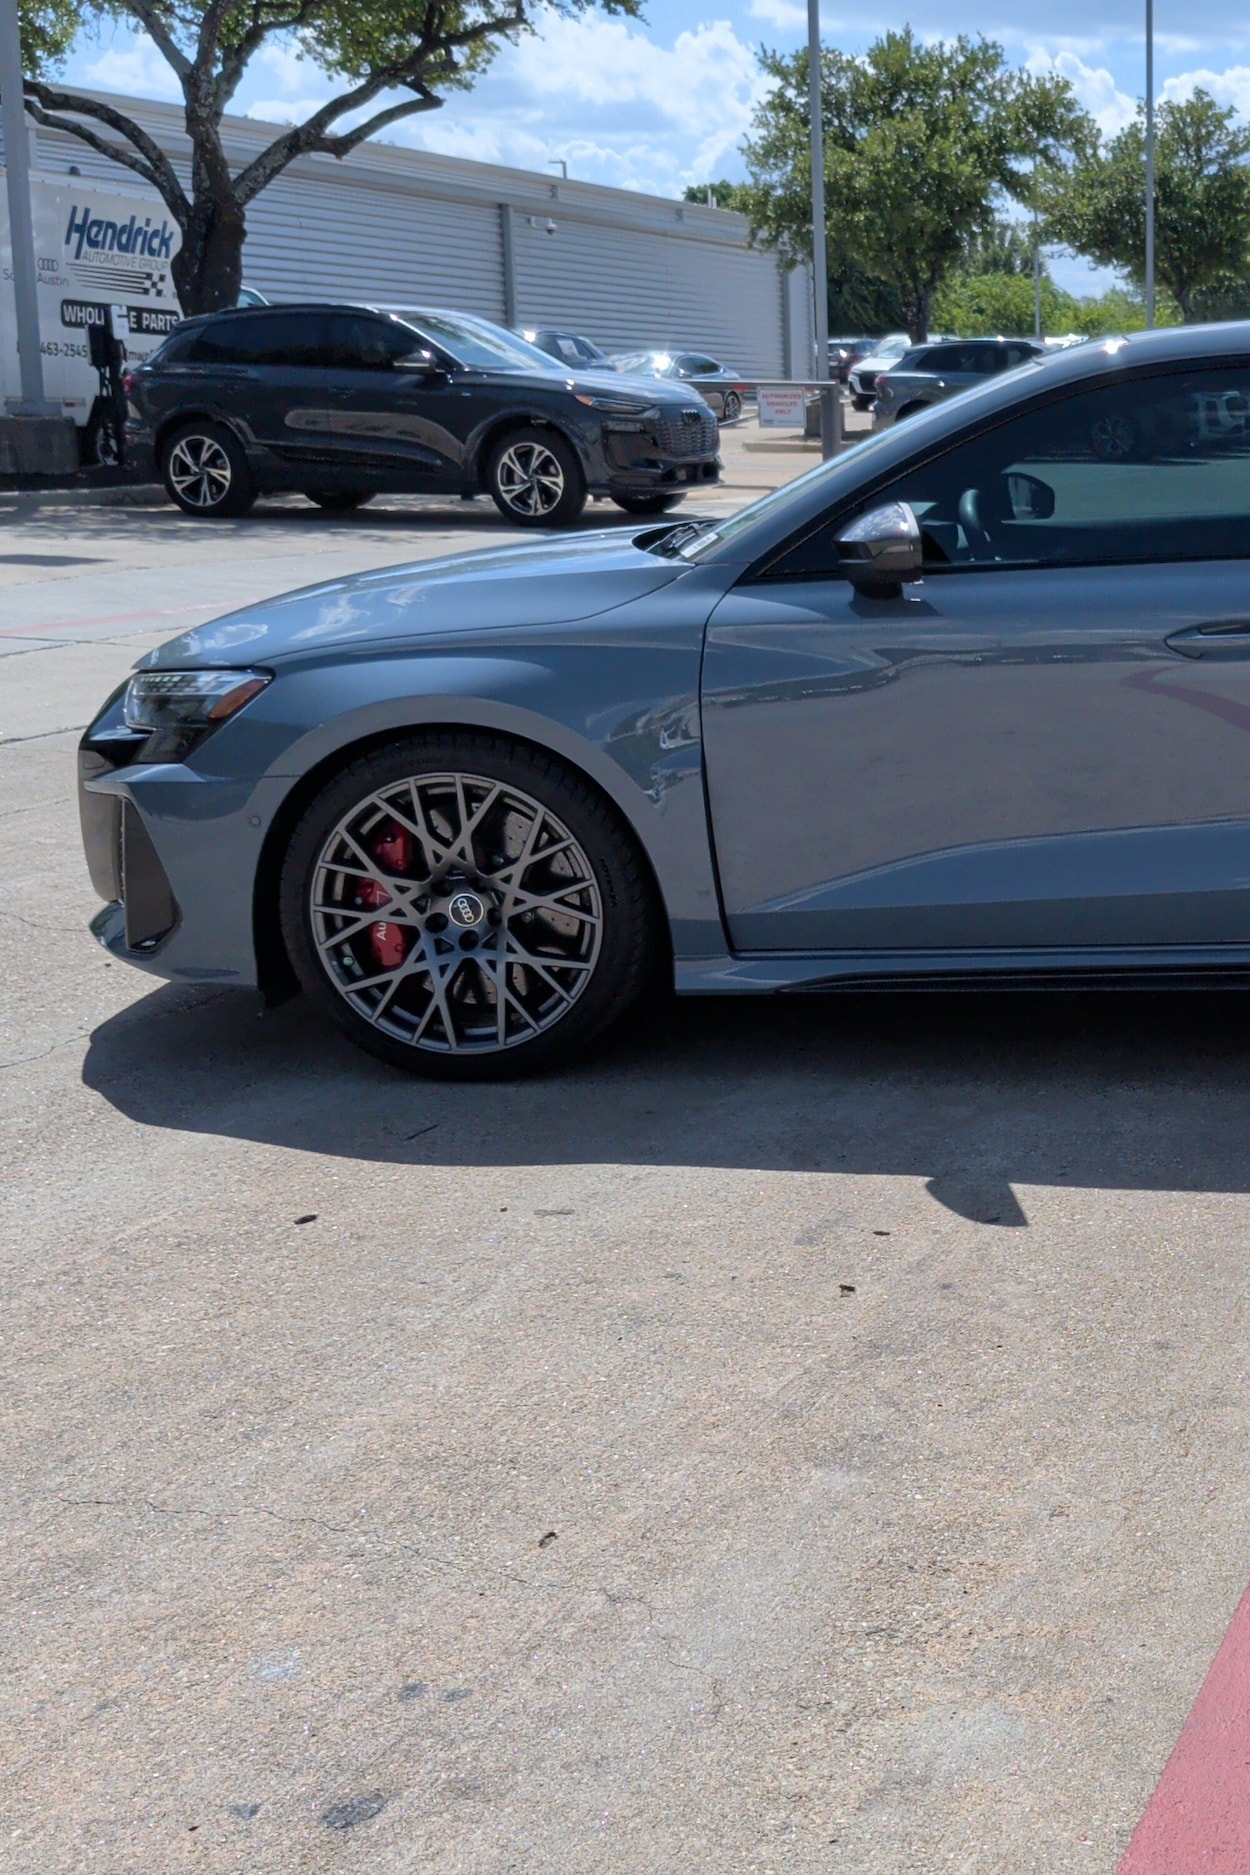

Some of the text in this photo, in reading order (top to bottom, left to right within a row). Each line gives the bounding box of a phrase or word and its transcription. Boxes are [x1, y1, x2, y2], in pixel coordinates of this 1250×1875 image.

[64, 205, 174, 260] Hendrick
[82, 250, 170, 273] AUTOMOTIVE GROUP
[37, 272, 70, 287] Austin
